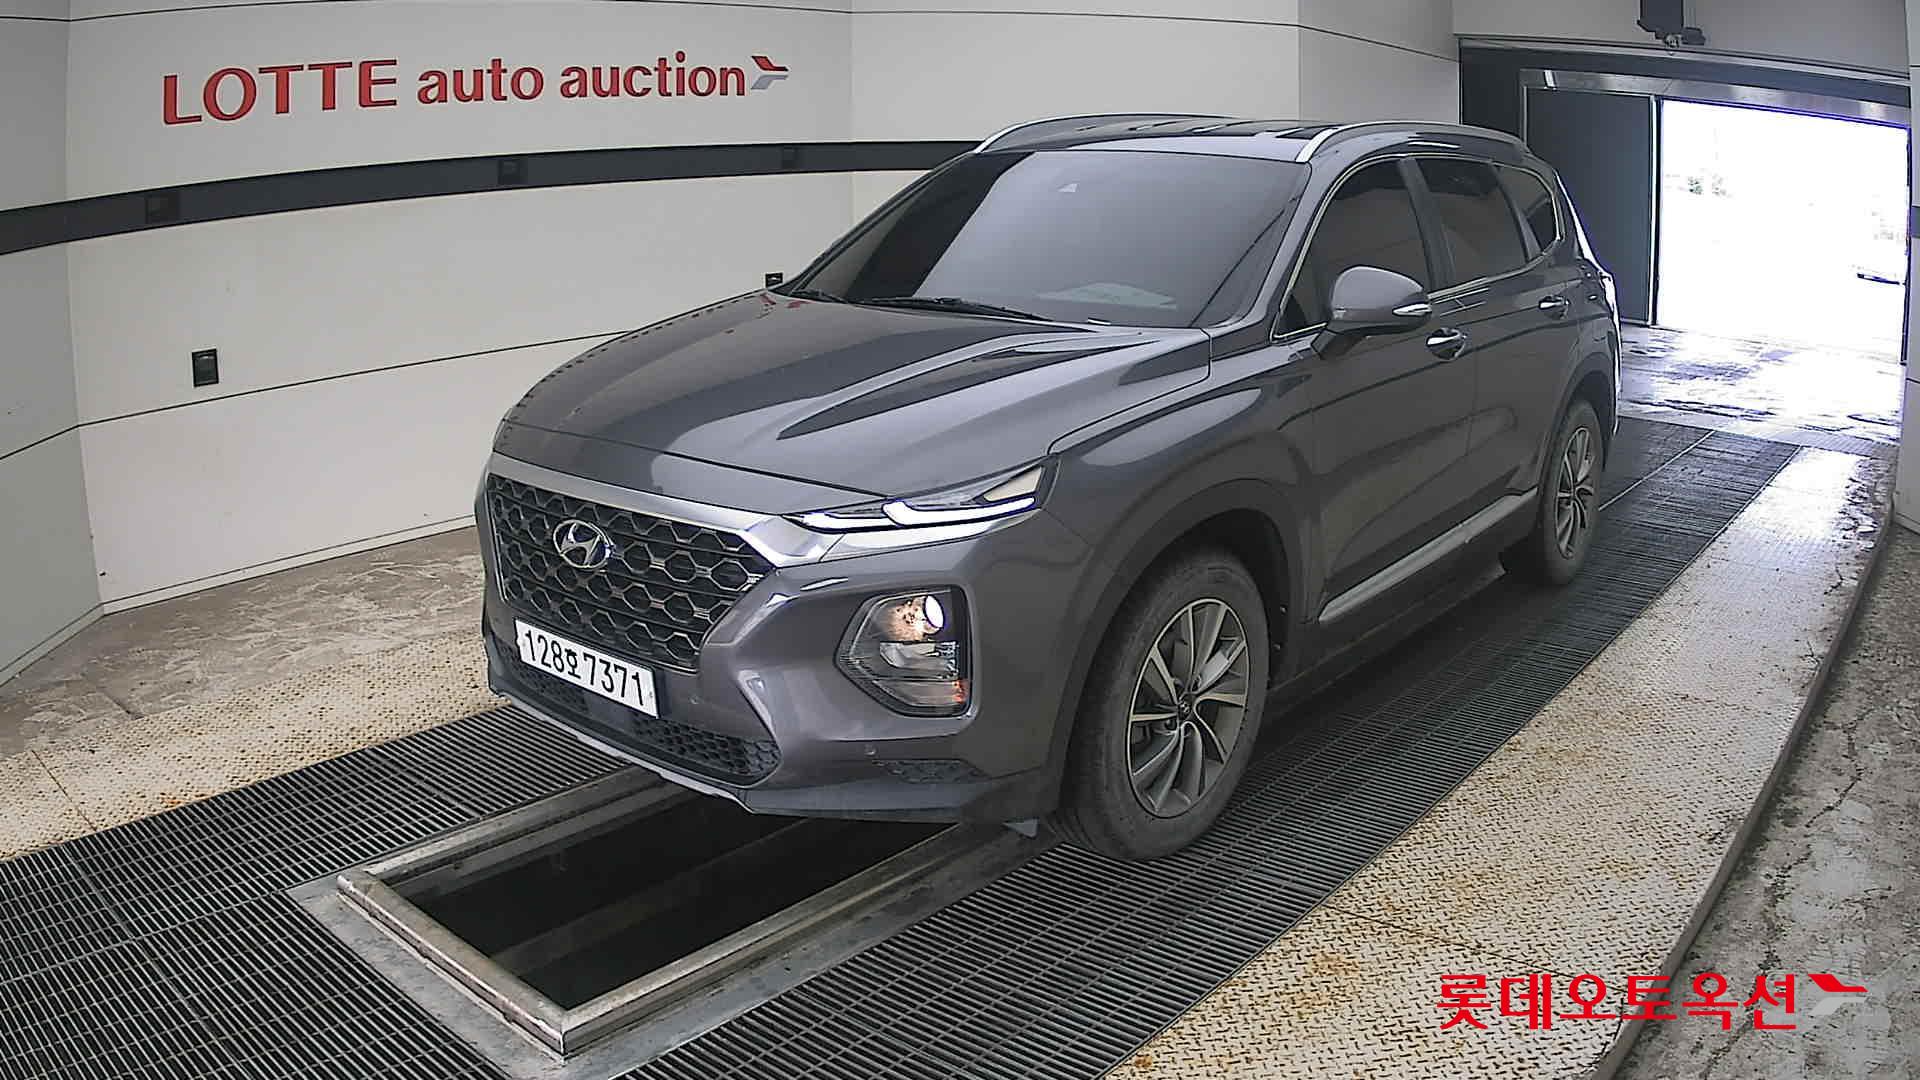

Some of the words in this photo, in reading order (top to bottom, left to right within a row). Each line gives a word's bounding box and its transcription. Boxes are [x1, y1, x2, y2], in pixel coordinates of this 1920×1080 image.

[163, 60, 398, 125] LOTTE
[418, 59, 544, 104] auto
[560, 51, 746, 98] auction
